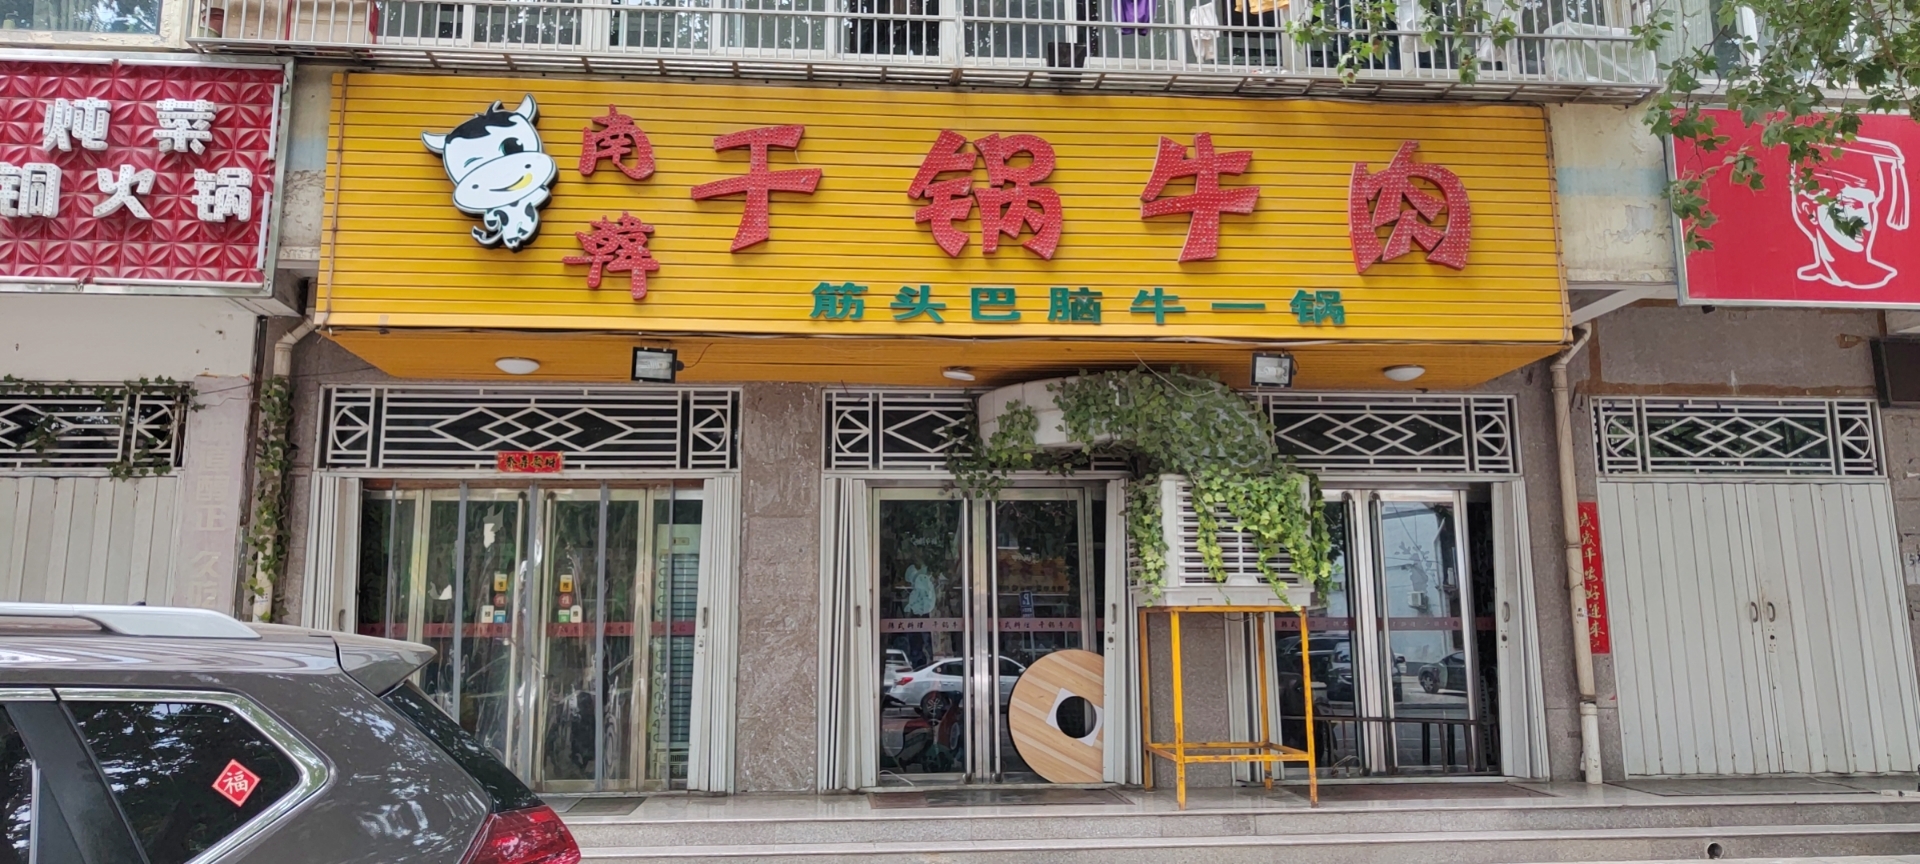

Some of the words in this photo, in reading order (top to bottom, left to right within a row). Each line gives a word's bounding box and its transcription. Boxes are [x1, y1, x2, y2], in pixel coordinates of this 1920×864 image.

[43, 97, 217, 155] 炖菜
[691, 124, 1471, 273] 干锅牛肉
[810, 281, 1346, 326] 筋头巴脑牛一锅
[223, 770, 249, 794] 福
